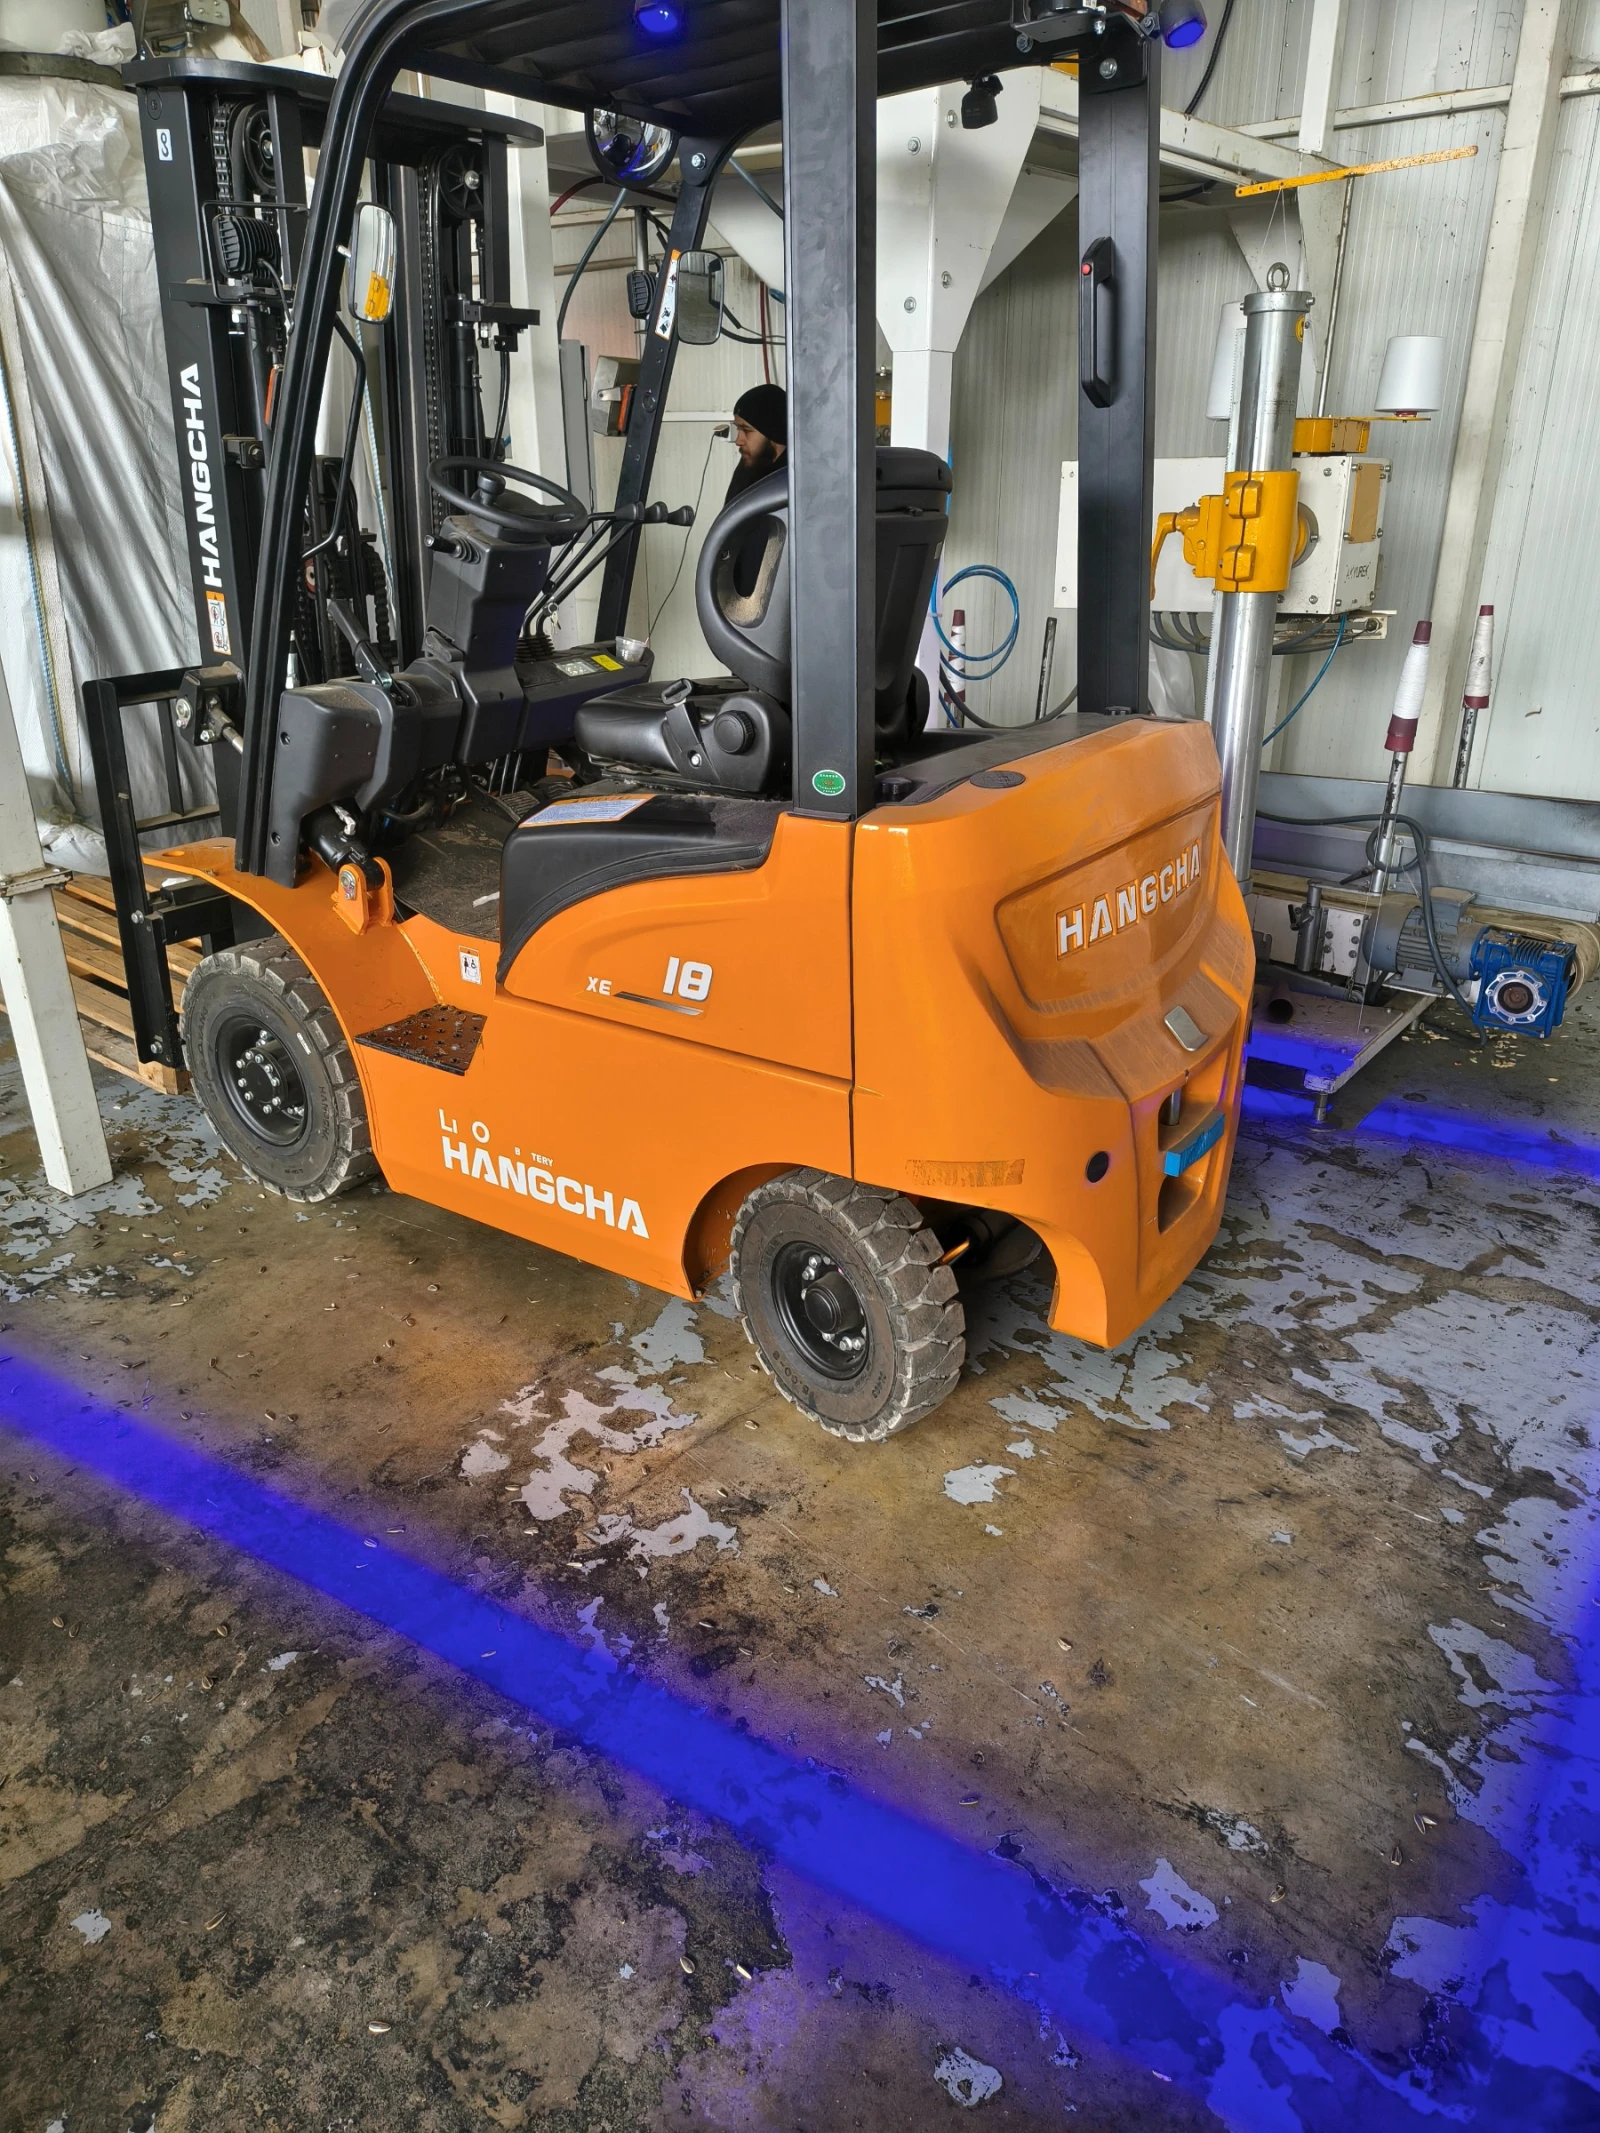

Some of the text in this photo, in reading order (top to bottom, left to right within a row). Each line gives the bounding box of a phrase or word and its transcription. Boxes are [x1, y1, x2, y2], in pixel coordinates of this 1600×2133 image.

[180, 362, 222, 588] HANGCHA
[1058, 842, 1201, 956] HANGCHA
[586, 956, 713, 1002] XE 18
[442, 1135, 650, 1239] HANGCHA
